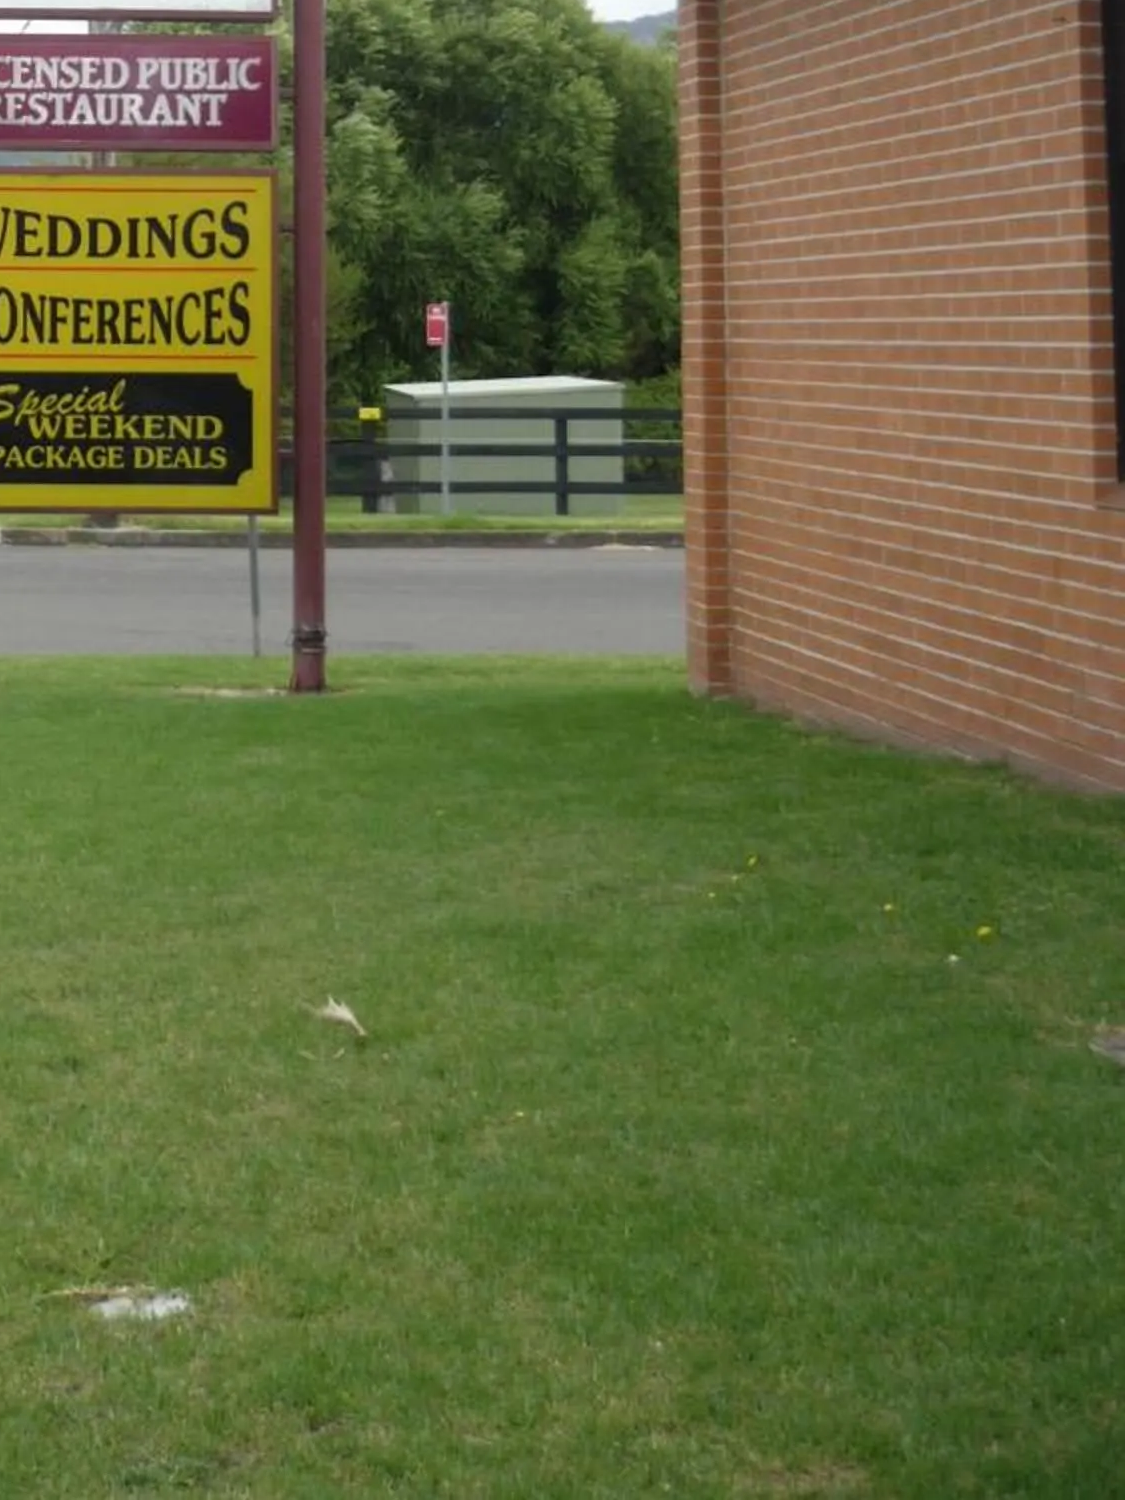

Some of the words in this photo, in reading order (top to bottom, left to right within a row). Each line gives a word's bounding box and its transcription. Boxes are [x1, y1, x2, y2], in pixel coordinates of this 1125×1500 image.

[137, 57, 262, 90] PUBLIC
[27, 414, 224, 440] WEEKEND
[133, 446, 228, 470] DEALS
